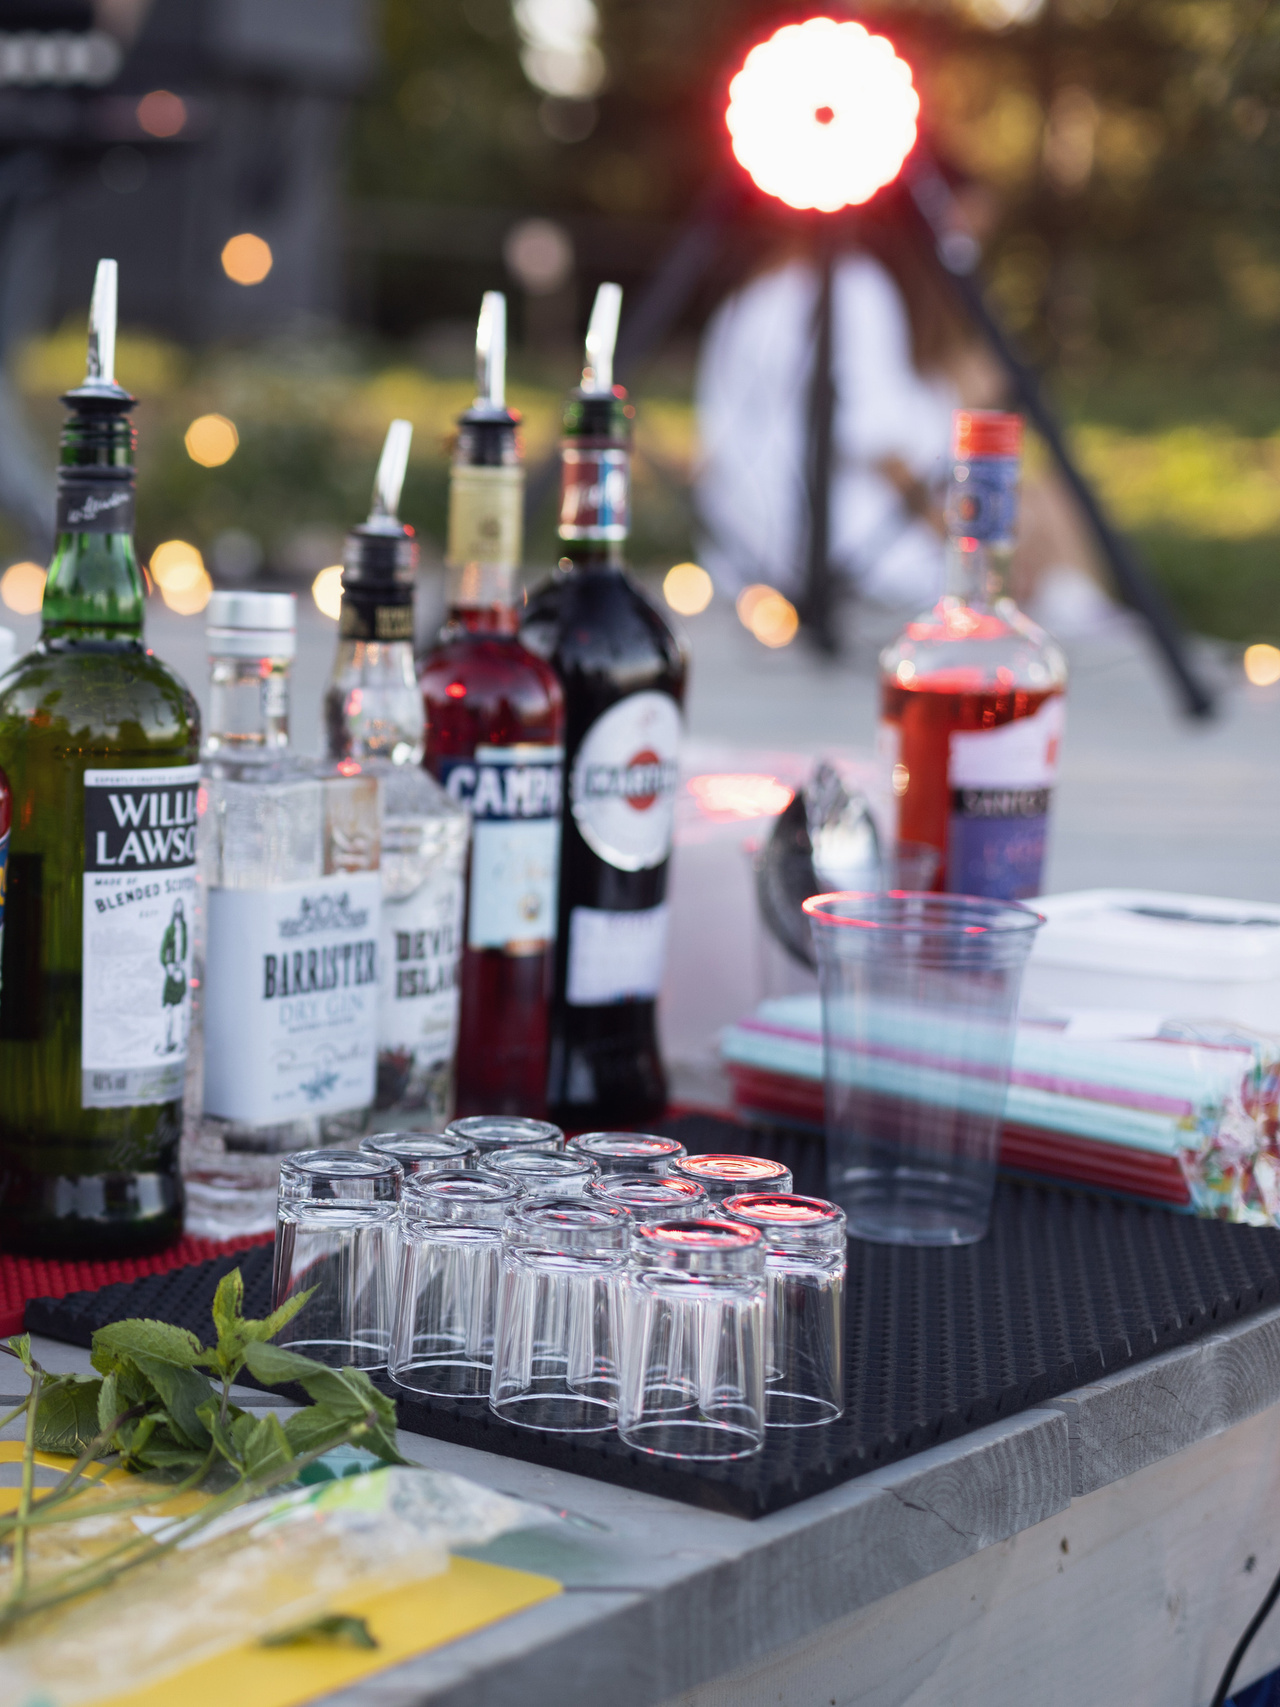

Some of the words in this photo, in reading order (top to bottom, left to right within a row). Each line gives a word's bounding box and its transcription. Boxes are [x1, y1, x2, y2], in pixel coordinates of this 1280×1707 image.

[108, 791, 197, 827] WILLI
[95, 884, 160, 913] BLENDED
[264, 940, 376, 999] BARRISTER
